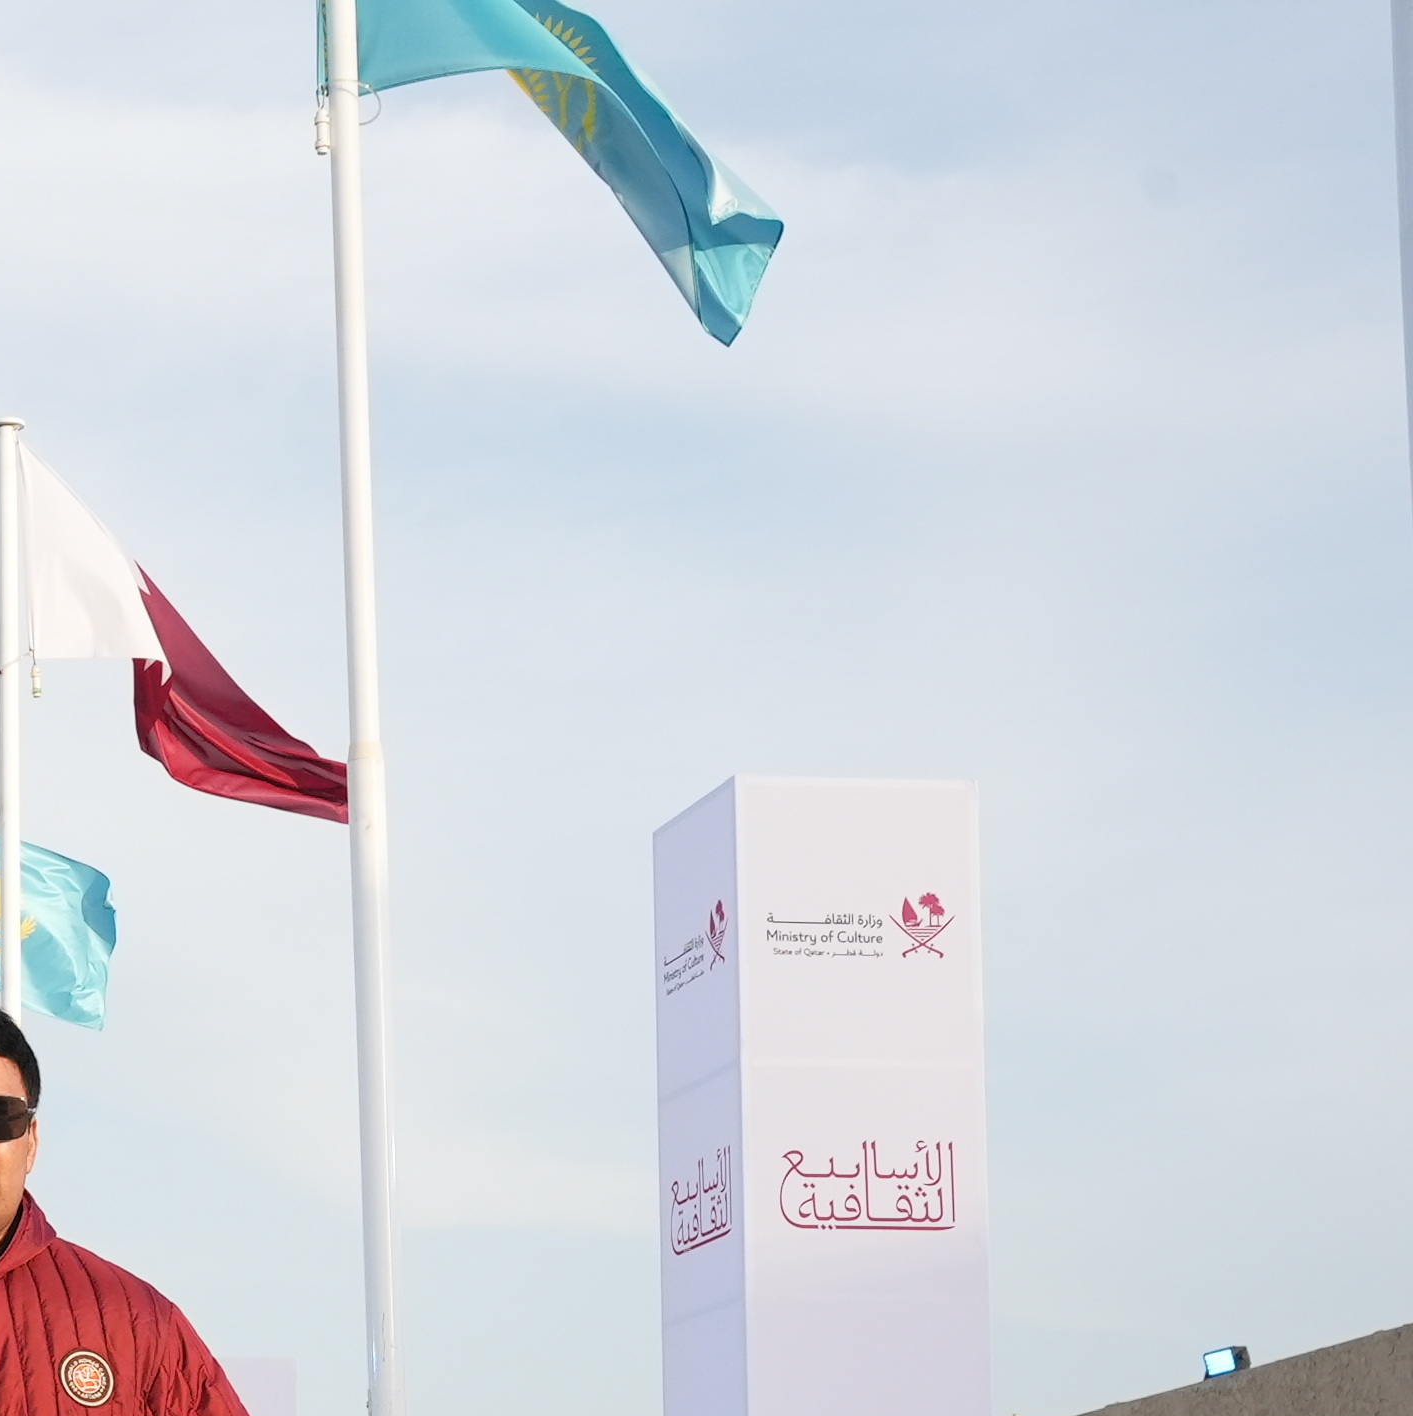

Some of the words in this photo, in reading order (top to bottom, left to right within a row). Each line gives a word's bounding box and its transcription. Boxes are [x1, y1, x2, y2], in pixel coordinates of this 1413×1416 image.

[857, 913, 883, 929] وزارة
[766, 929, 817, 946] Ministry
[820, 930, 834, 943] of
[837, 930, 883, 944] Culture
